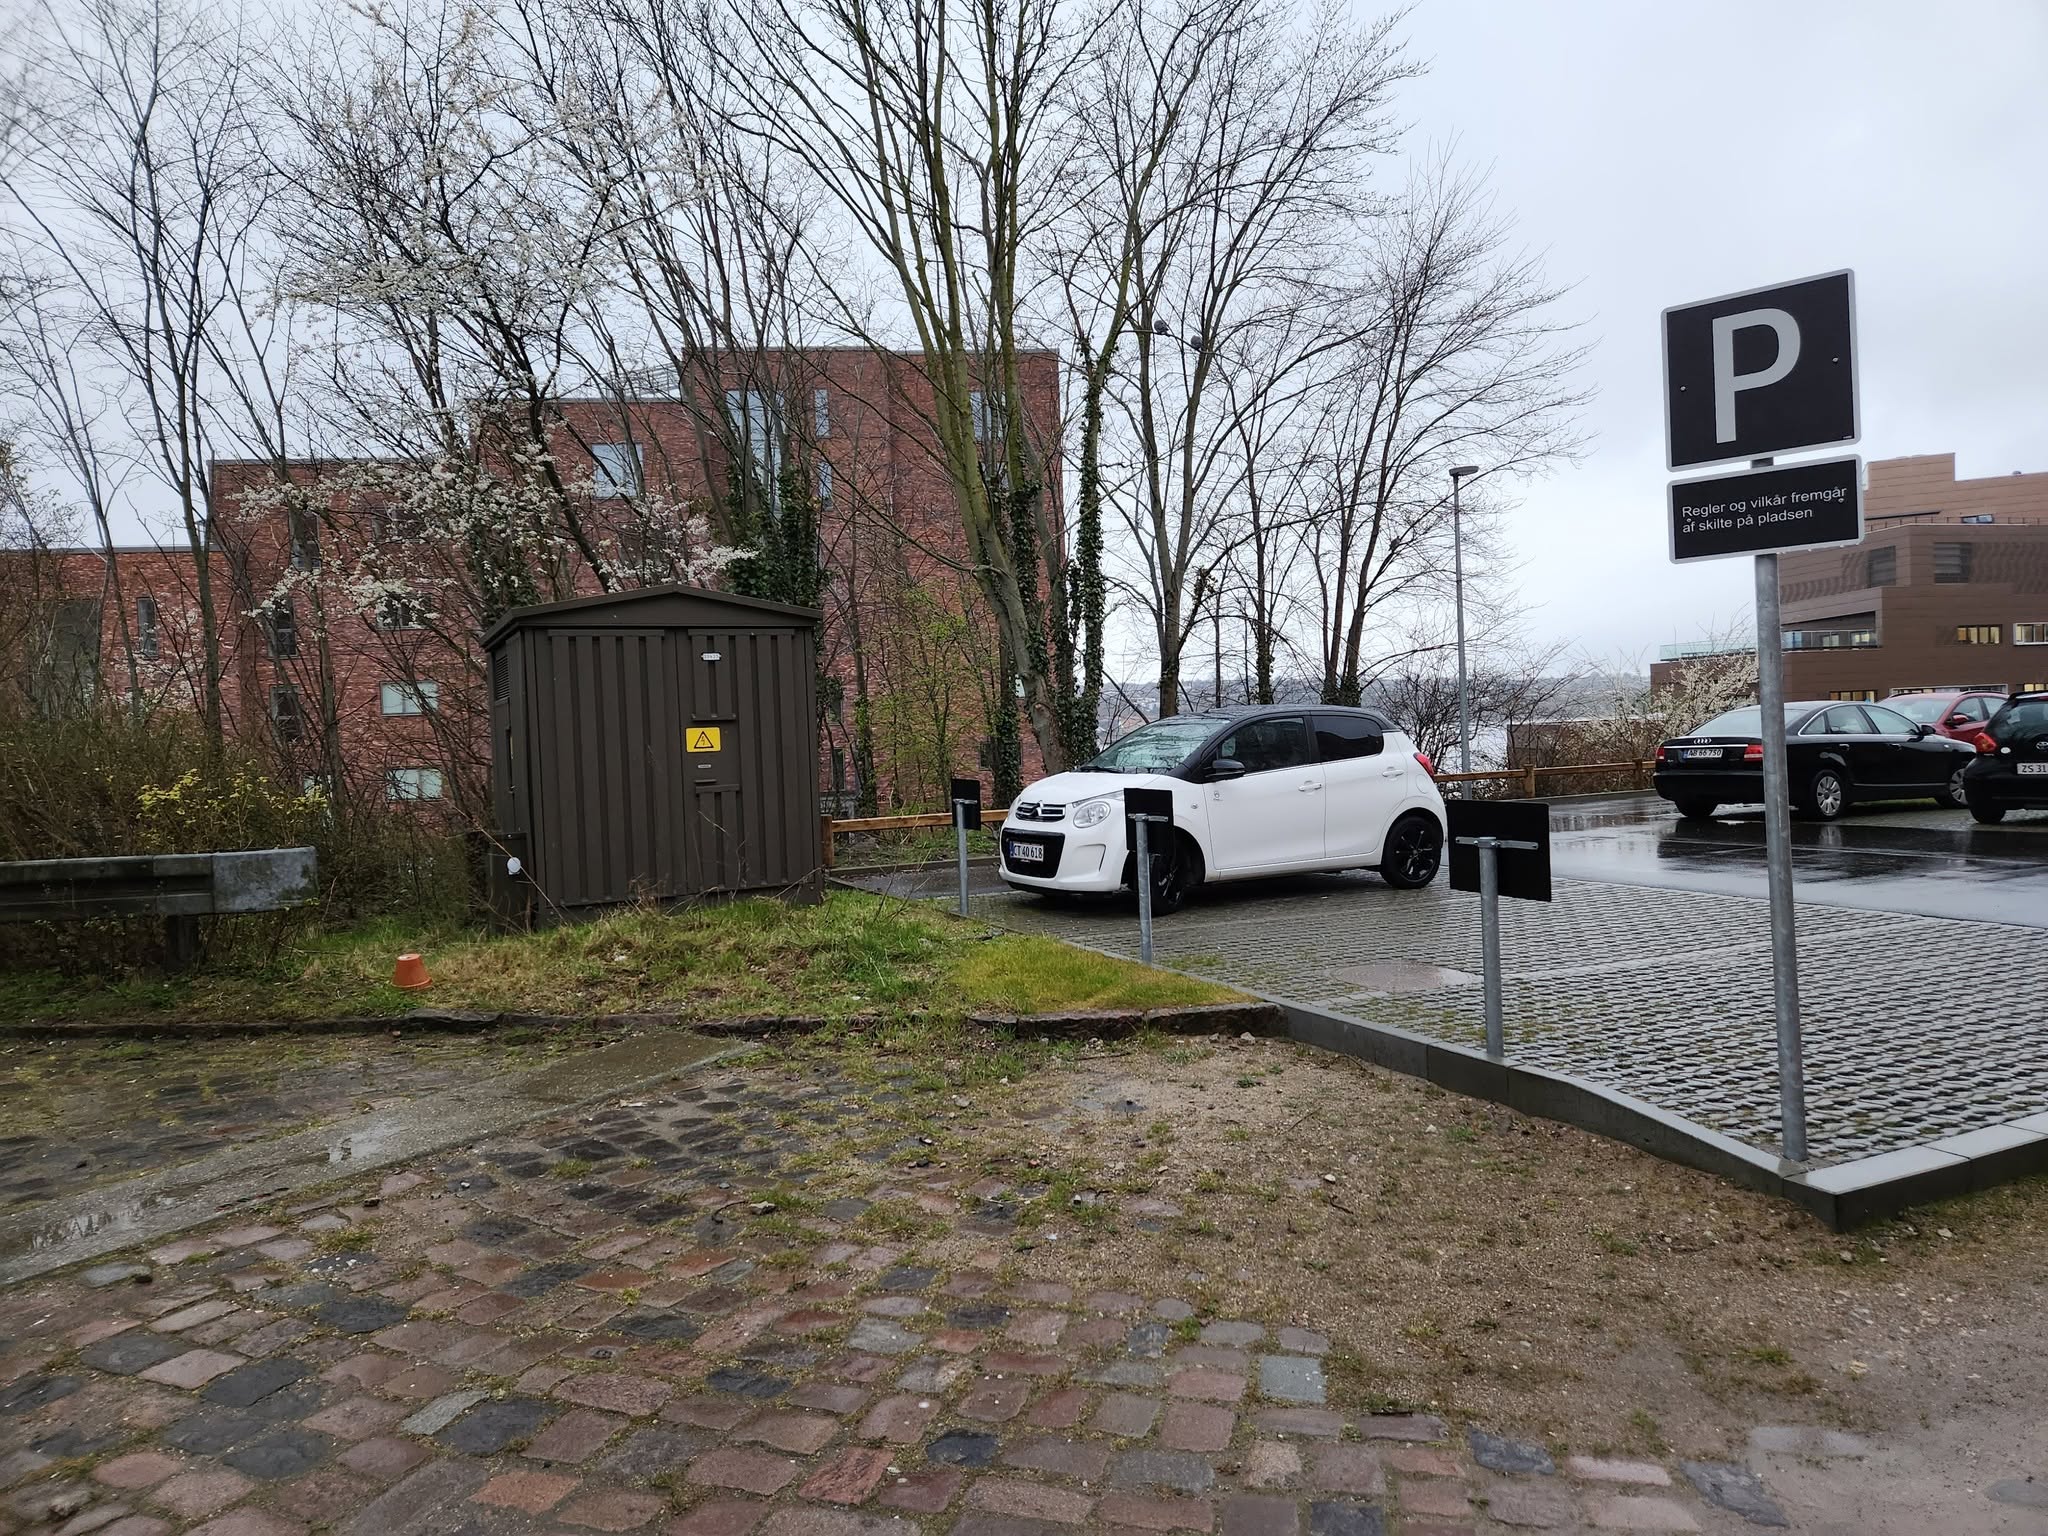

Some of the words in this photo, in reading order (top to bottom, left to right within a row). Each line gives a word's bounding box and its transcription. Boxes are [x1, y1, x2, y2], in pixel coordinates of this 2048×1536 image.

[1712, 308, 1801, 444] P
[1682, 503, 1726, 518] Regler
[1729, 500, 1746, 513] og
[1750, 494, 1788, 508] vilkår
[1791, 486, 1847, 503] fremgår
[1682, 521, 1696, 533] af
[1698, 517, 1733, 531] skilte
[1736, 514, 1754, 529] på
[1758, 508, 1813, 527] pladsen
[2021, 764, 2034, 773] ZS
[1022, 845, 1030, 858] 40
[1030, 846, 1043, 860] 618
